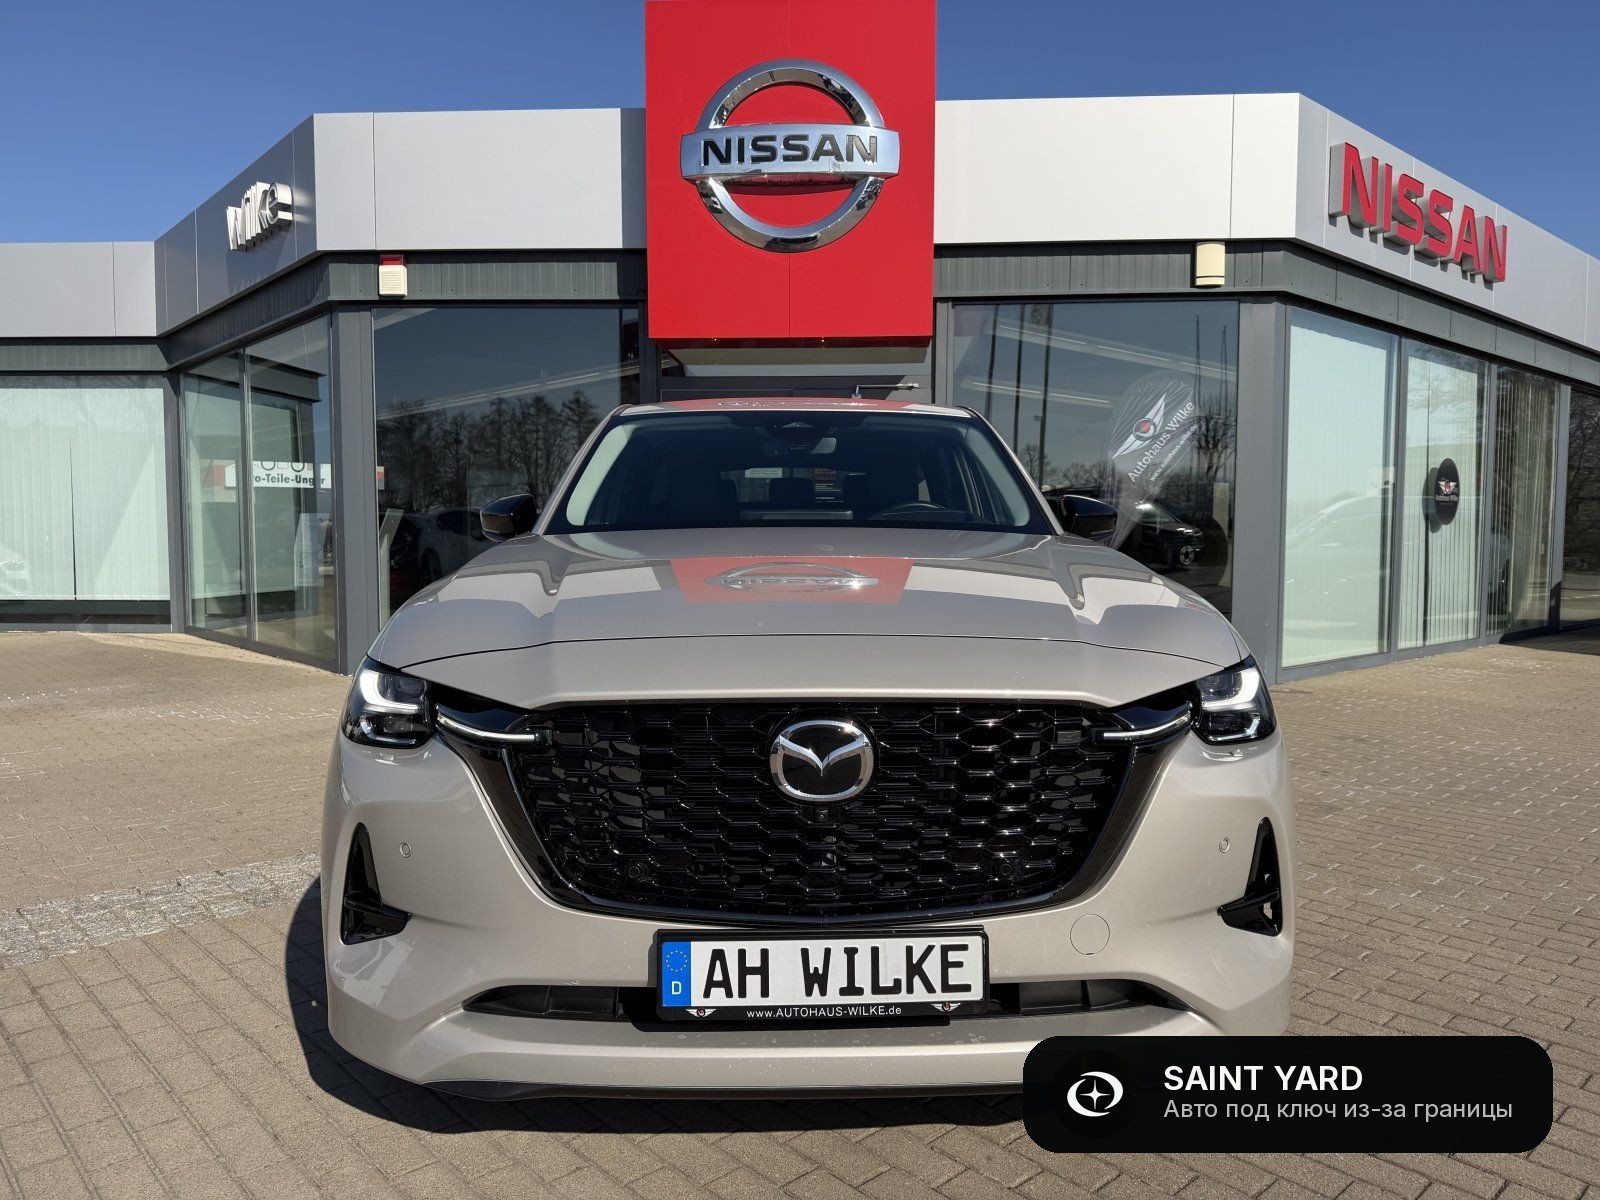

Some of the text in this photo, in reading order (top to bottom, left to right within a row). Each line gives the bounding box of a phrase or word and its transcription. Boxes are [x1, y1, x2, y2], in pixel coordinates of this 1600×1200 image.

[702, 134, 878, 167] NISSAN
[1338, 141, 1508, 283] NISSAN
[1127, 402, 1195, 482] Autohaus Wilke
[671, 944, 971, 998] D AH WILKE
[746, 1005, 902, 1018] www.AUTOHAUS-WILKE.de
